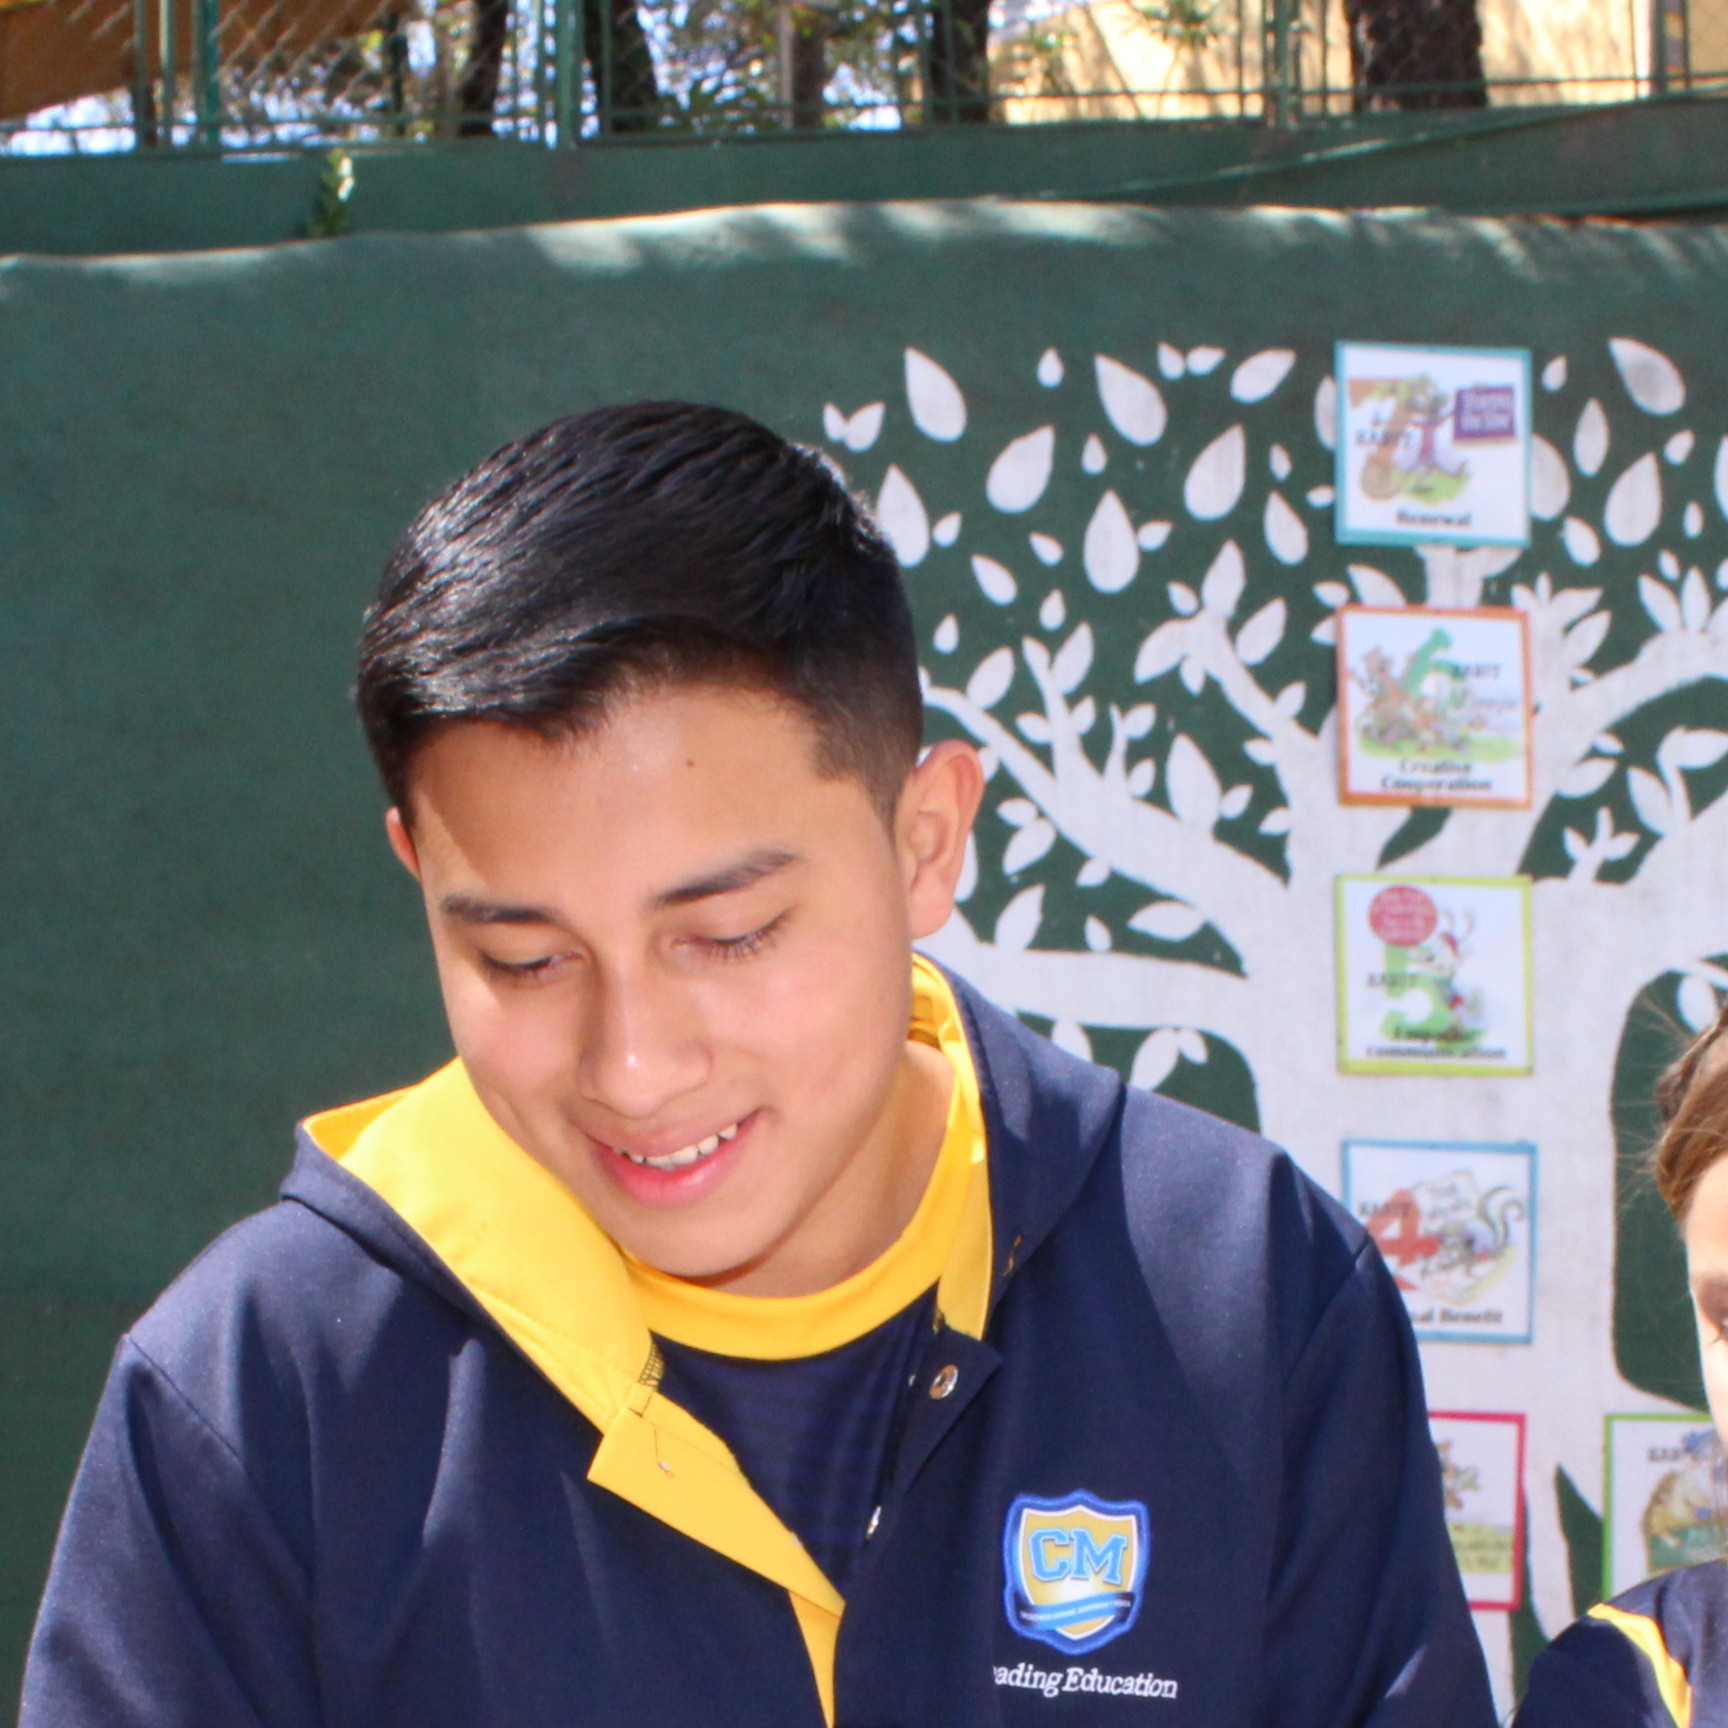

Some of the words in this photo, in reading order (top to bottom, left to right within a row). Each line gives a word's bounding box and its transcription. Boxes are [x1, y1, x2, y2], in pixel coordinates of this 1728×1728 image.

[1028, 1528, 1128, 1585] CM
[993, 1662, 1060, 1698] ading
[1062, 1667, 1178, 1699] Education
